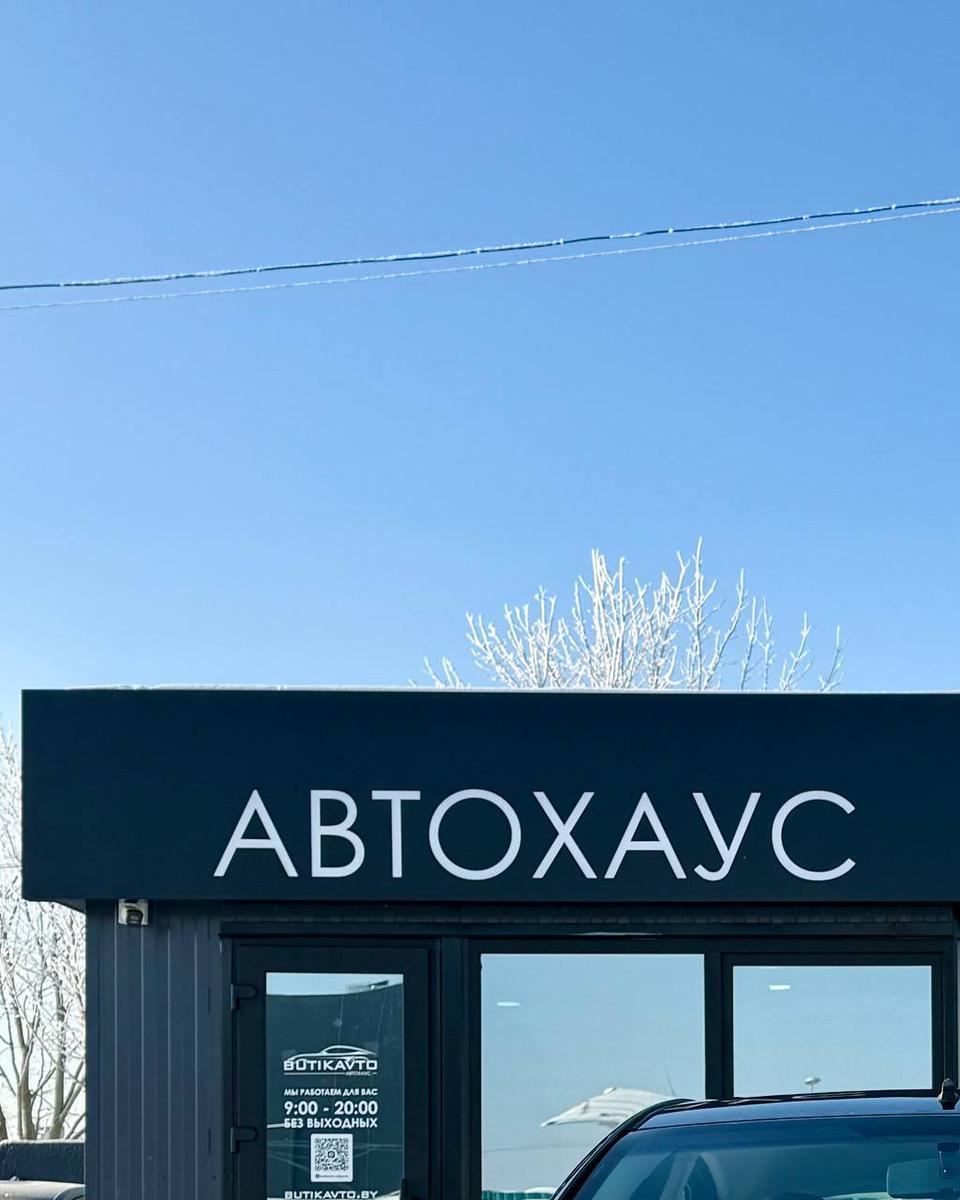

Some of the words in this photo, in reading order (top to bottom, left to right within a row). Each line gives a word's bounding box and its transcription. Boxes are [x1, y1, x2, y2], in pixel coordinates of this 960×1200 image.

[213, 788, 857, 882] АВТОХАУС
[283, 1059, 378, 1071] BUTIKAVTO
[284, 1088, 299, 1096] МЫ
[300, 1088, 341, 1096] РАБОТАЕМ
[342, 1088, 359, 1096] ДЛЯ
[361, 1088, 378, 1096] ВАС
[284, 1100, 318, 1115] 9:00
[334, 1100, 378, 1115] 20:00
[284, 1118, 304, 1129] БЕЗ
[306, 1117, 378, 1129] ВЫХОДНЫХ
[284, 1190, 379, 1199] BUTIKAVTO.BY
